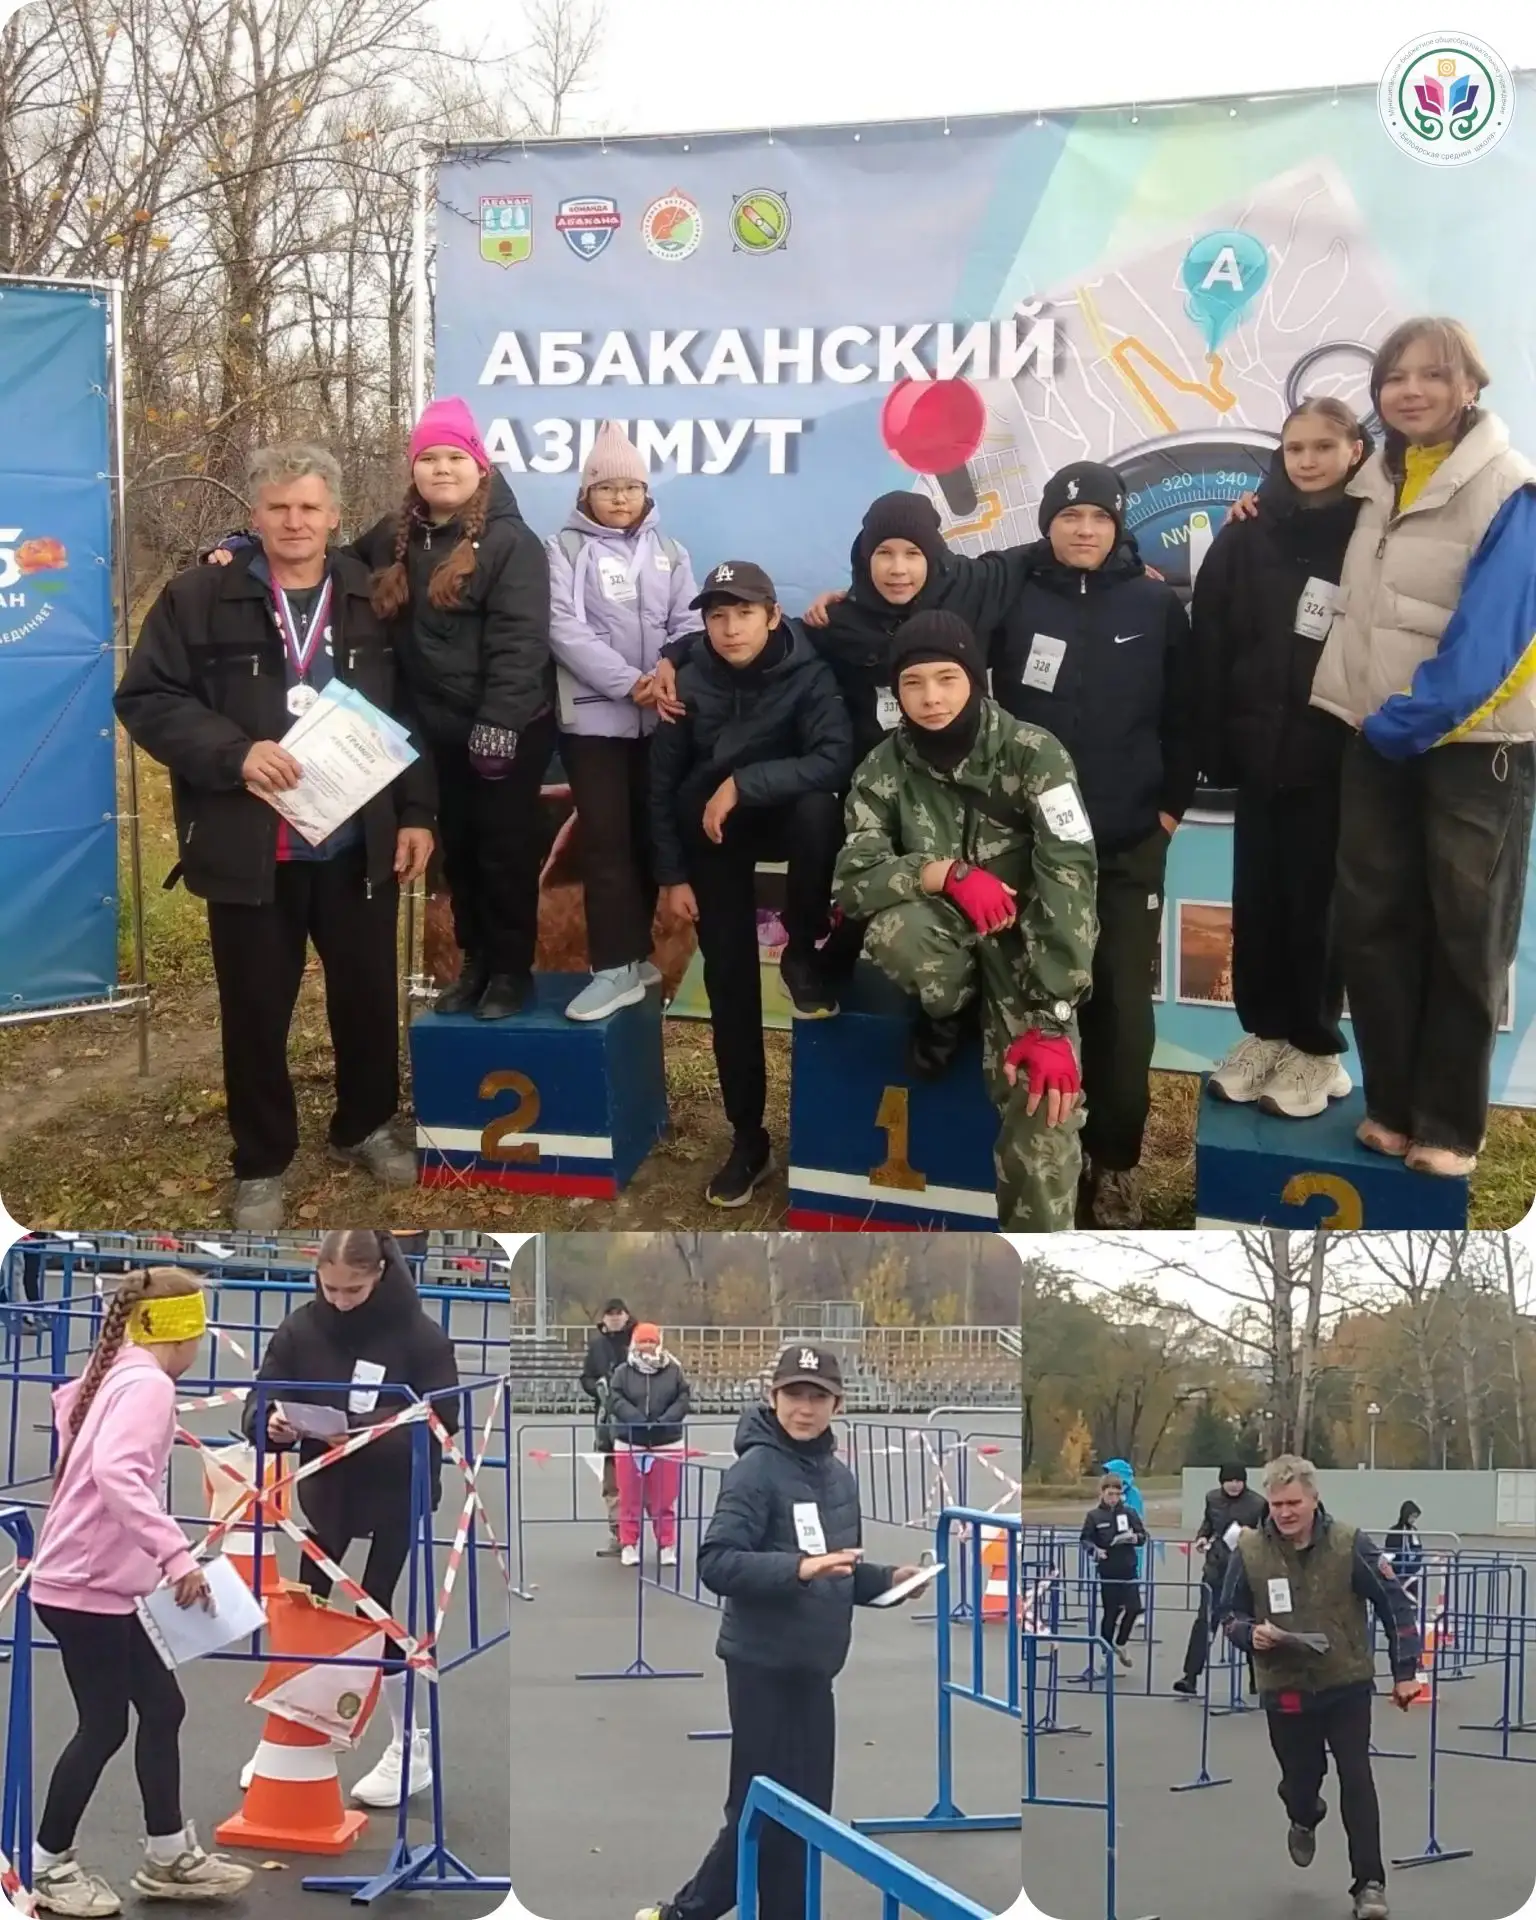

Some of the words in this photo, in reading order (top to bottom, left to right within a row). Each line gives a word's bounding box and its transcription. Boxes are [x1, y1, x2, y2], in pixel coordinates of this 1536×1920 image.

[557, 216, 620, 227] АБАКАНА
[478, 299, 1056, 386] АБАКАНСКИЙ
[1161, 472, 1193, 493] 320
[1215, 470, 1248, 487] 340
[715, 564, 735, 583] LA
[1304, 601, 1326, 617] 324
[1032, 659, 1051, 674] 328
[1056, 809, 1074, 827] 329
[478, 1070, 540, 1165] 2
[868, 1085, 927, 1192] 1
[798, 1347, 819, 1370] LA
